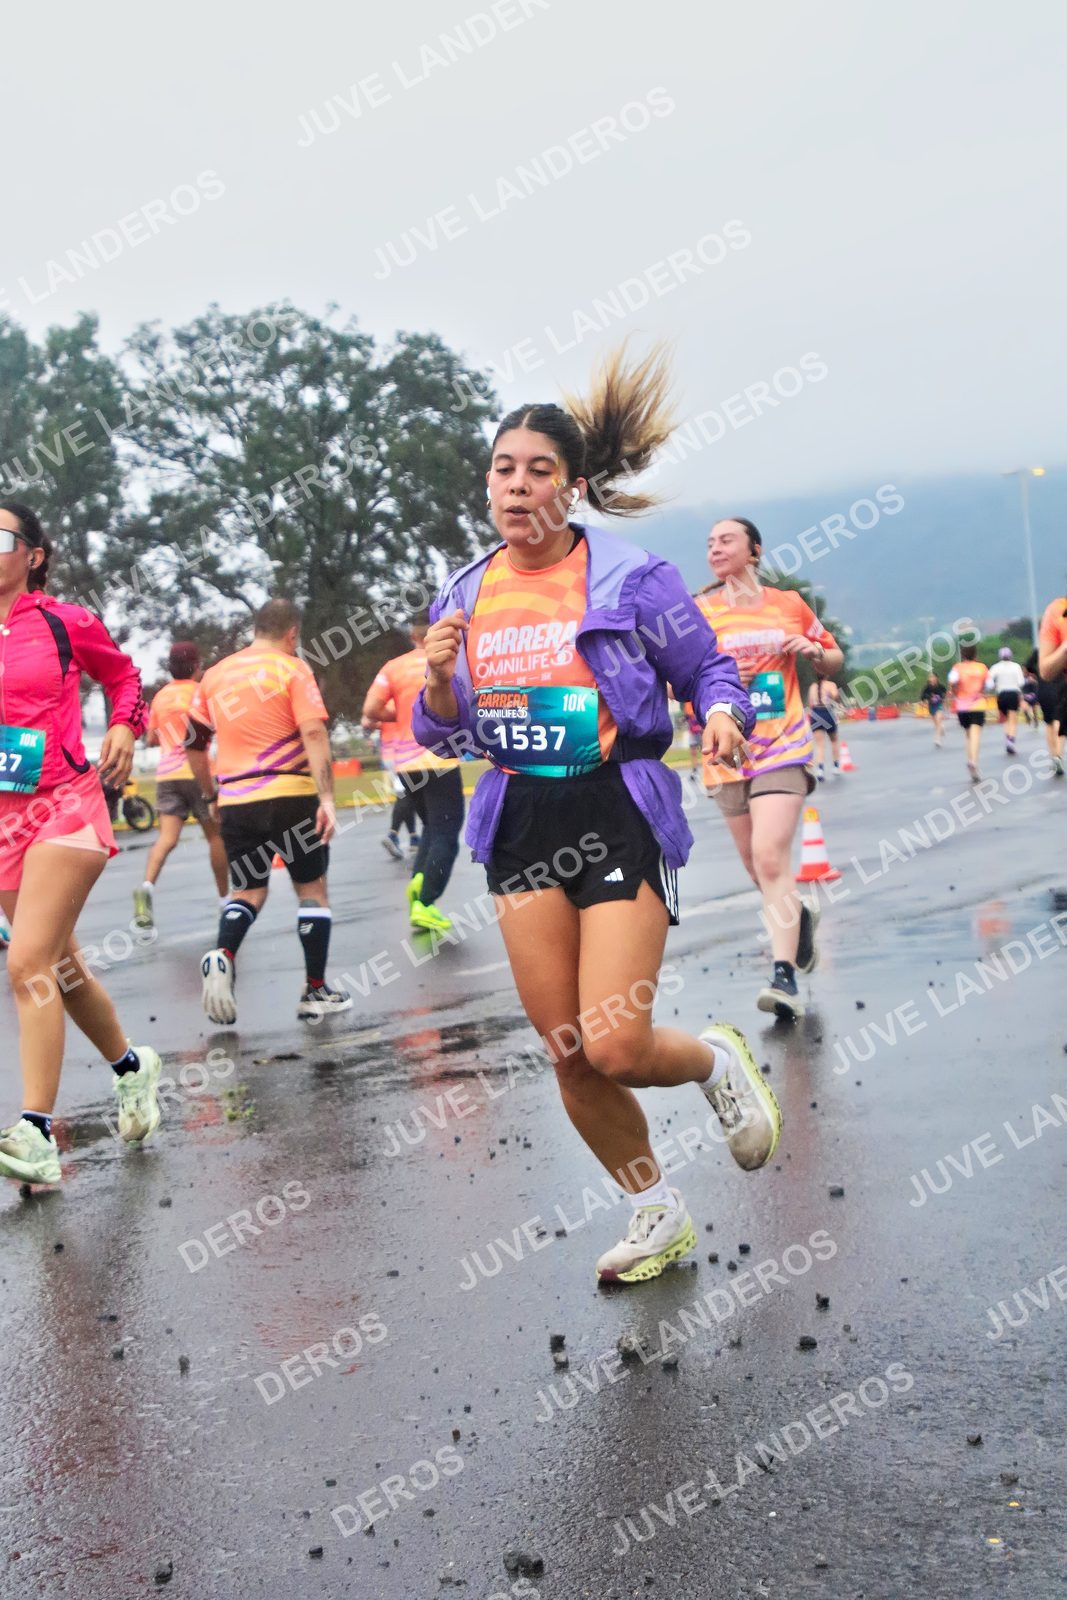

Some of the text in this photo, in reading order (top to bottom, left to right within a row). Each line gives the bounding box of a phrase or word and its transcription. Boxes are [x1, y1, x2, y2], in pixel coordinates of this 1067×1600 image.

[477, 620, 578, 660] CARRERA
[476, 653, 552, 679] OMNILIFE
[478, 693, 588, 712] CARRERA 10K
[19, 732, 38, 748] 10K
[493, 726, 567, 751] 1537
